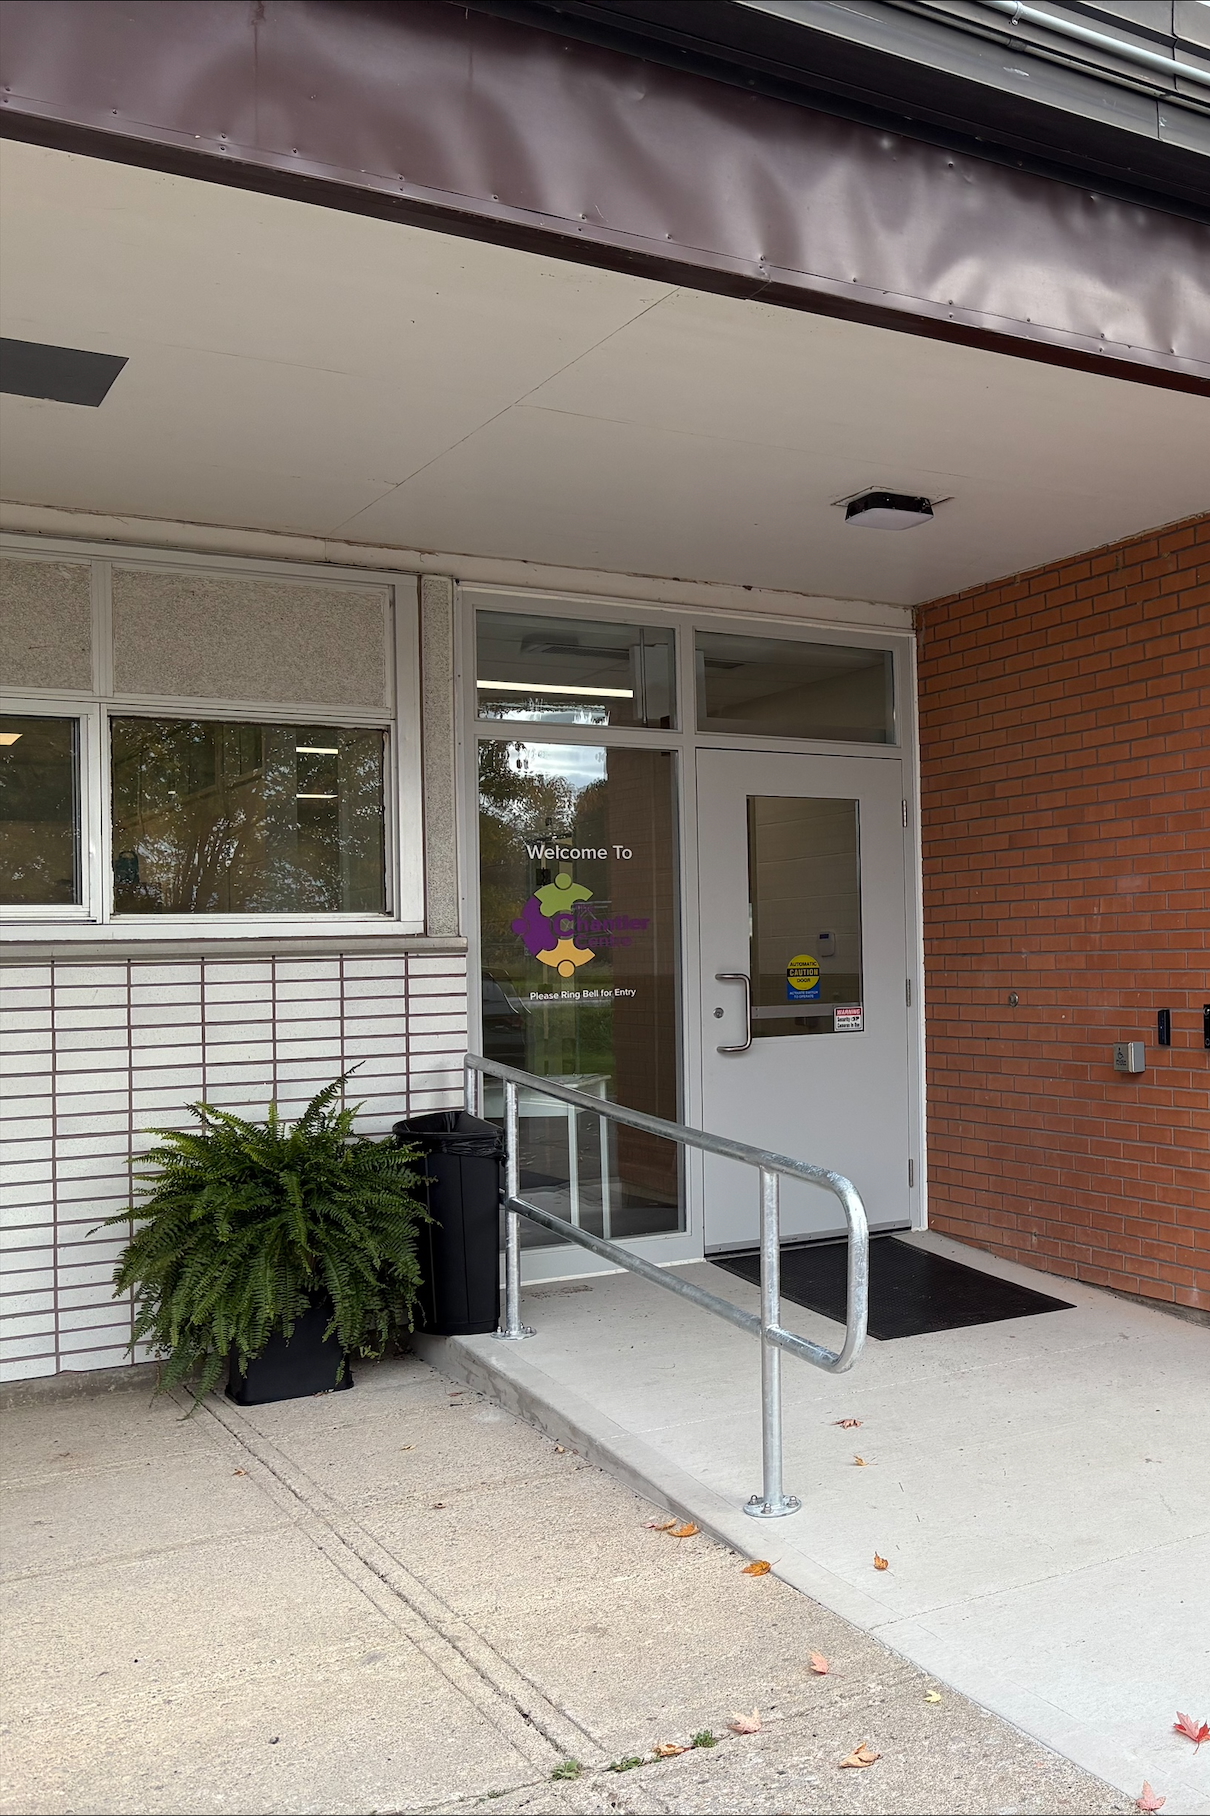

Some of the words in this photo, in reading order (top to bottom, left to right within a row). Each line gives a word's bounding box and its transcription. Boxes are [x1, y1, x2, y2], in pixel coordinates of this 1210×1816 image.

[526, 845, 608, 860] Welcome
[612, 845, 633, 860] To
[553, 913, 650, 937] Chantler
[575, 934, 633, 948] Centre
[530, 991, 559, 1000] Please
[561, 991, 580, 1000] Ring
[582, 989, 599, 998] Bell
[600, 989, 613, 997] for
[614, 988, 637, 997] Entry
